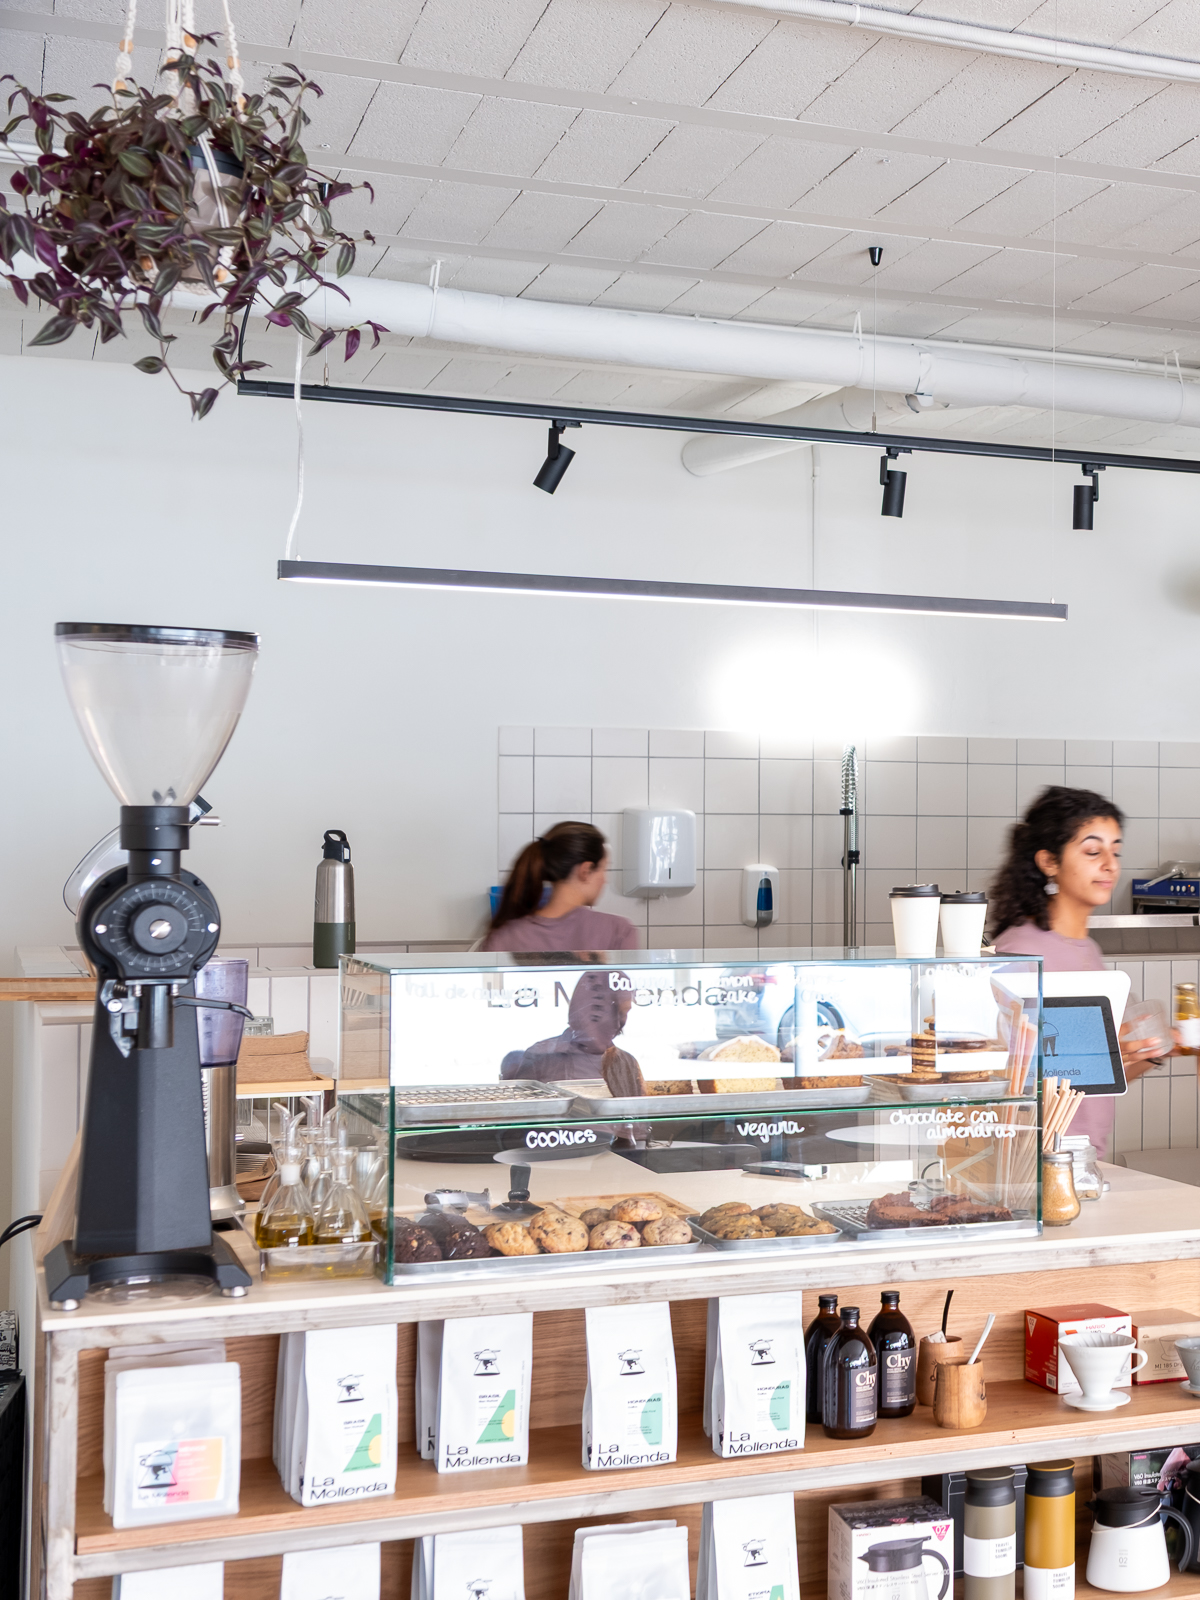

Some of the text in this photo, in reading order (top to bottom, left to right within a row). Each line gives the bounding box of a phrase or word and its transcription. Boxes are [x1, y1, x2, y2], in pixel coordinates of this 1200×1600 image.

[736, 1119, 805, 1144] vegana
[926, 1122, 1017, 1140] almendras
[886, 1353, 912, 1370] Chy
[855, 1371, 877, 1388] Chy
[729, 1431, 751, 1442] La
[446, 1444, 469, 1456] La
[599, 1443, 620, 1455] La
[311, 1476, 335, 1488] La
[935, 1525, 946, 1534] 02
